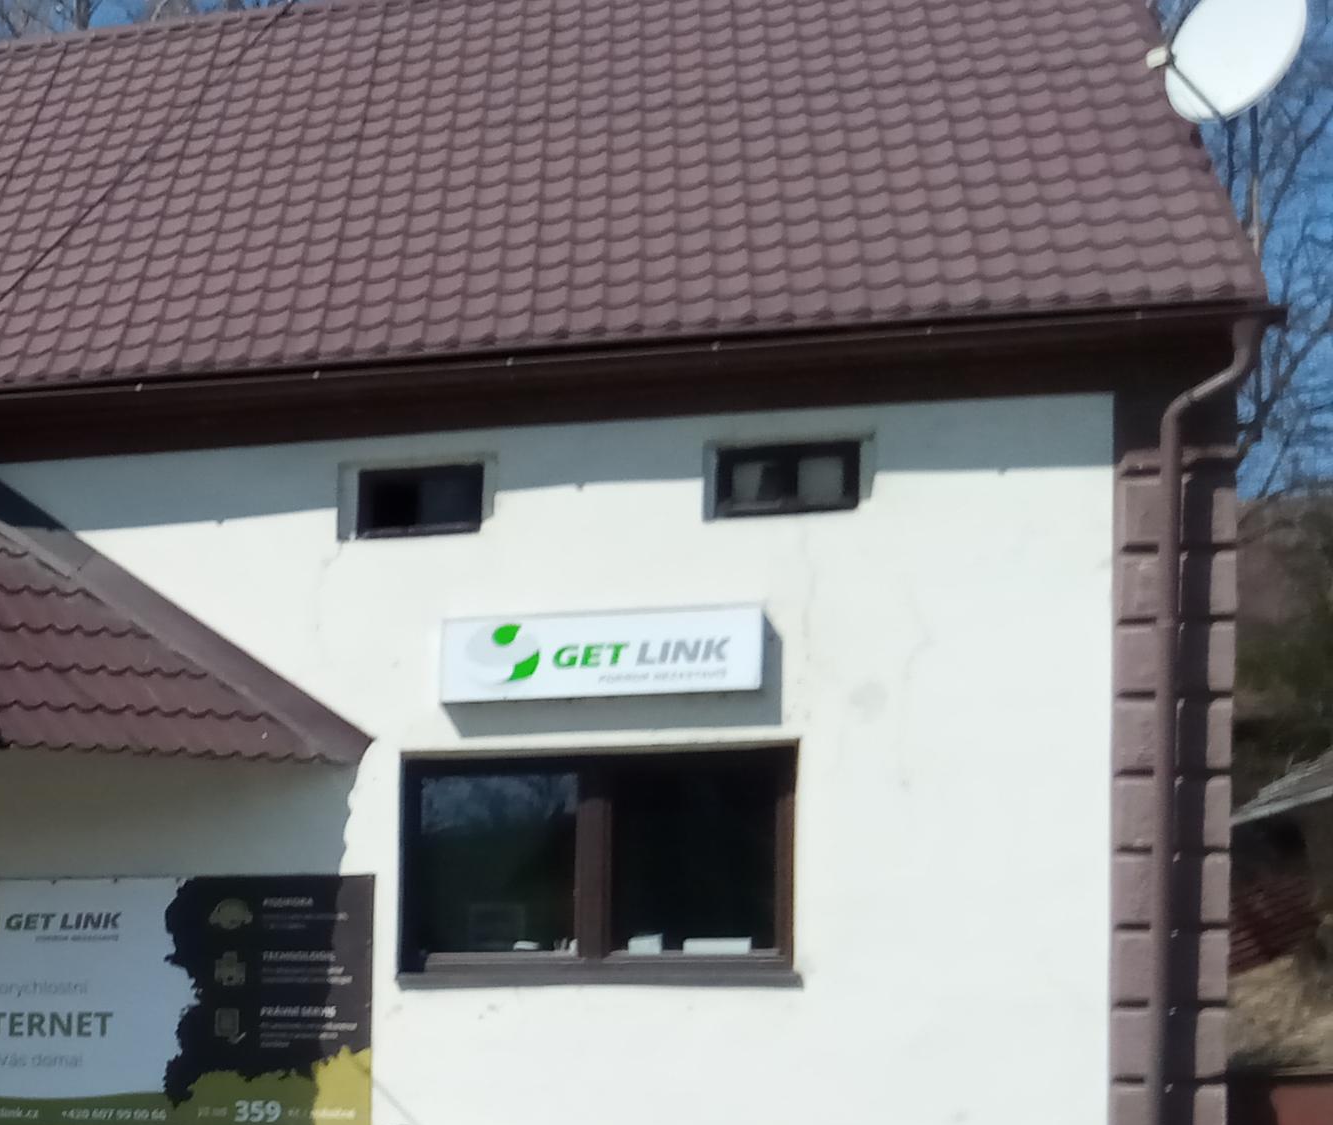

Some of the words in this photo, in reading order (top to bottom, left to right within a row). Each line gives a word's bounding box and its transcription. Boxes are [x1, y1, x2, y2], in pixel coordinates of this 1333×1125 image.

[552, 641, 629, 669] GET
[635, 636, 731, 667] LINK
[4, 912, 57, 931] GET
[60, 911, 122, 931] LINK
[234, 1100, 282, 1123] 359
